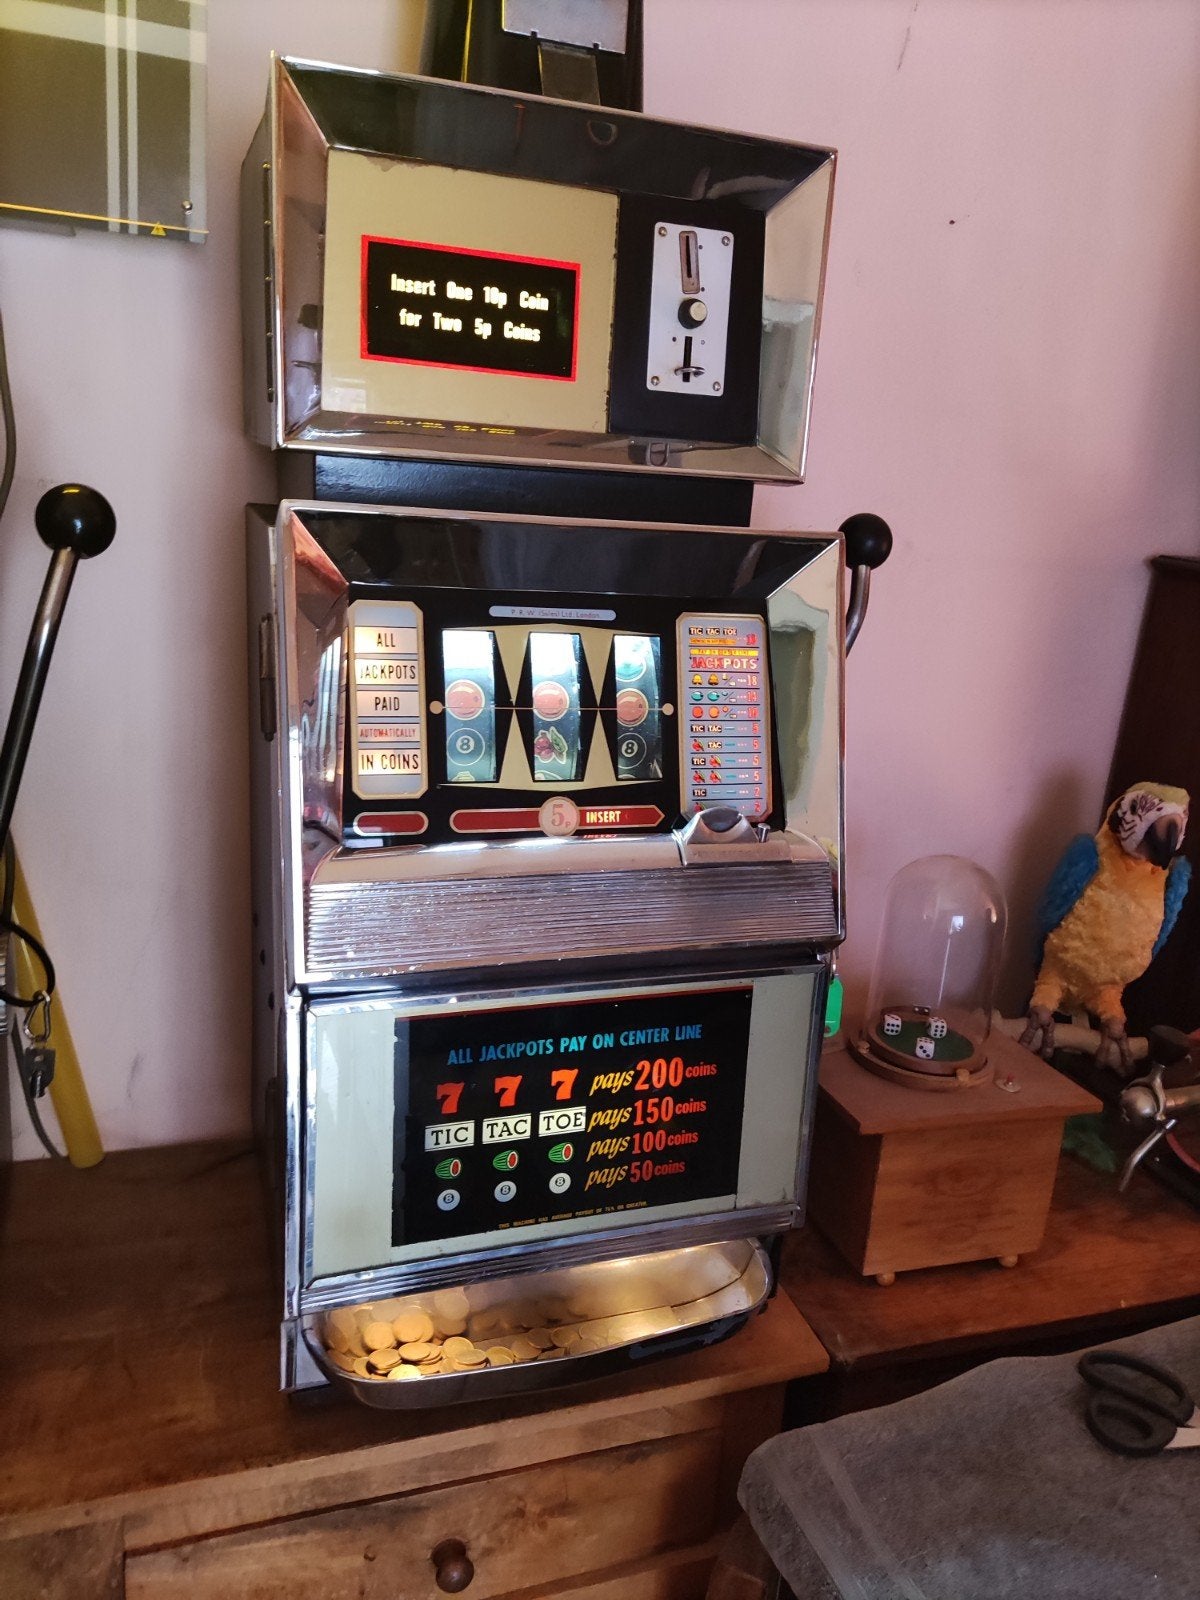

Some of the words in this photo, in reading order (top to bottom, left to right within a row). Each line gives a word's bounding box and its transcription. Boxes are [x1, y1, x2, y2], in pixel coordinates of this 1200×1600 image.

[391, 273, 436, 296] Insert
[446, 281, 473, 301] One
[483, 286, 507, 309] 10p
[519, 291, 549, 311] Coin
[399, 308, 422, 327] for
[433, 312, 462, 332] Two
[474, 318, 491, 339] 5p
[503, 321, 541, 342] Coins
[690, 627, 703, 635] TIC
[706, 627, 720, 635] TAC
[376, 632, 396, 648] ALL
[691, 656, 758, 670] JACKPOTS
[360, 664, 416, 679] JACKPOTS
[747, 674, 758, 686] 18
[374, 696, 400, 711] PAID
[359, 728, 416, 738] AUTOMATICALLY
[692, 724, 704, 732] TIC
[708, 724, 722, 732] TAC
[708, 741, 722, 749] TAC
[752, 739, 759, 750] 5
[361, 755, 373, 770] IN
[381, 754, 419, 770] COINS
[752, 755, 759, 766] 5
[753, 771, 760, 781] 5
[753, 787, 760, 797] 2
[586, 811, 621, 823] INSERT
[447, 1047, 474, 1066] ALL
[479, 1038, 554, 1062] JACKPOTS
[560, 1034, 588, 1053] PAY
[592, 1032, 614, 1050] ON
[620, 1027, 670, 1047] CENTER
[675, 1024, 703, 1042] LINE
[436, 1081, 465, 1114] 7
[494, 1075, 523, 1107] 7
[551, 1068, 579, 1100] 7
[589, 1070, 635, 1096] pays
[634, 1057, 684, 1091] 200
[685, 1062, 718, 1078] coins
[431, 1126, 470, 1146] TIC
[486, 1119, 528, 1139] TAC
[543, 1111, 584, 1131] TOE
[587, 1107, 633, 1133] pays
[633, 1096, 674, 1126] 150
[675, 1098, 707, 1115] coins
[586, 1136, 631, 1162] pays
[632, 1129, 667, 1155] 100
[667, 1130, 699, 1146] coins
[584, 1165, 629, 1192] pays
[629, 1160, 653, 1183] 50
[654, 1160, 686, 1176] coins
